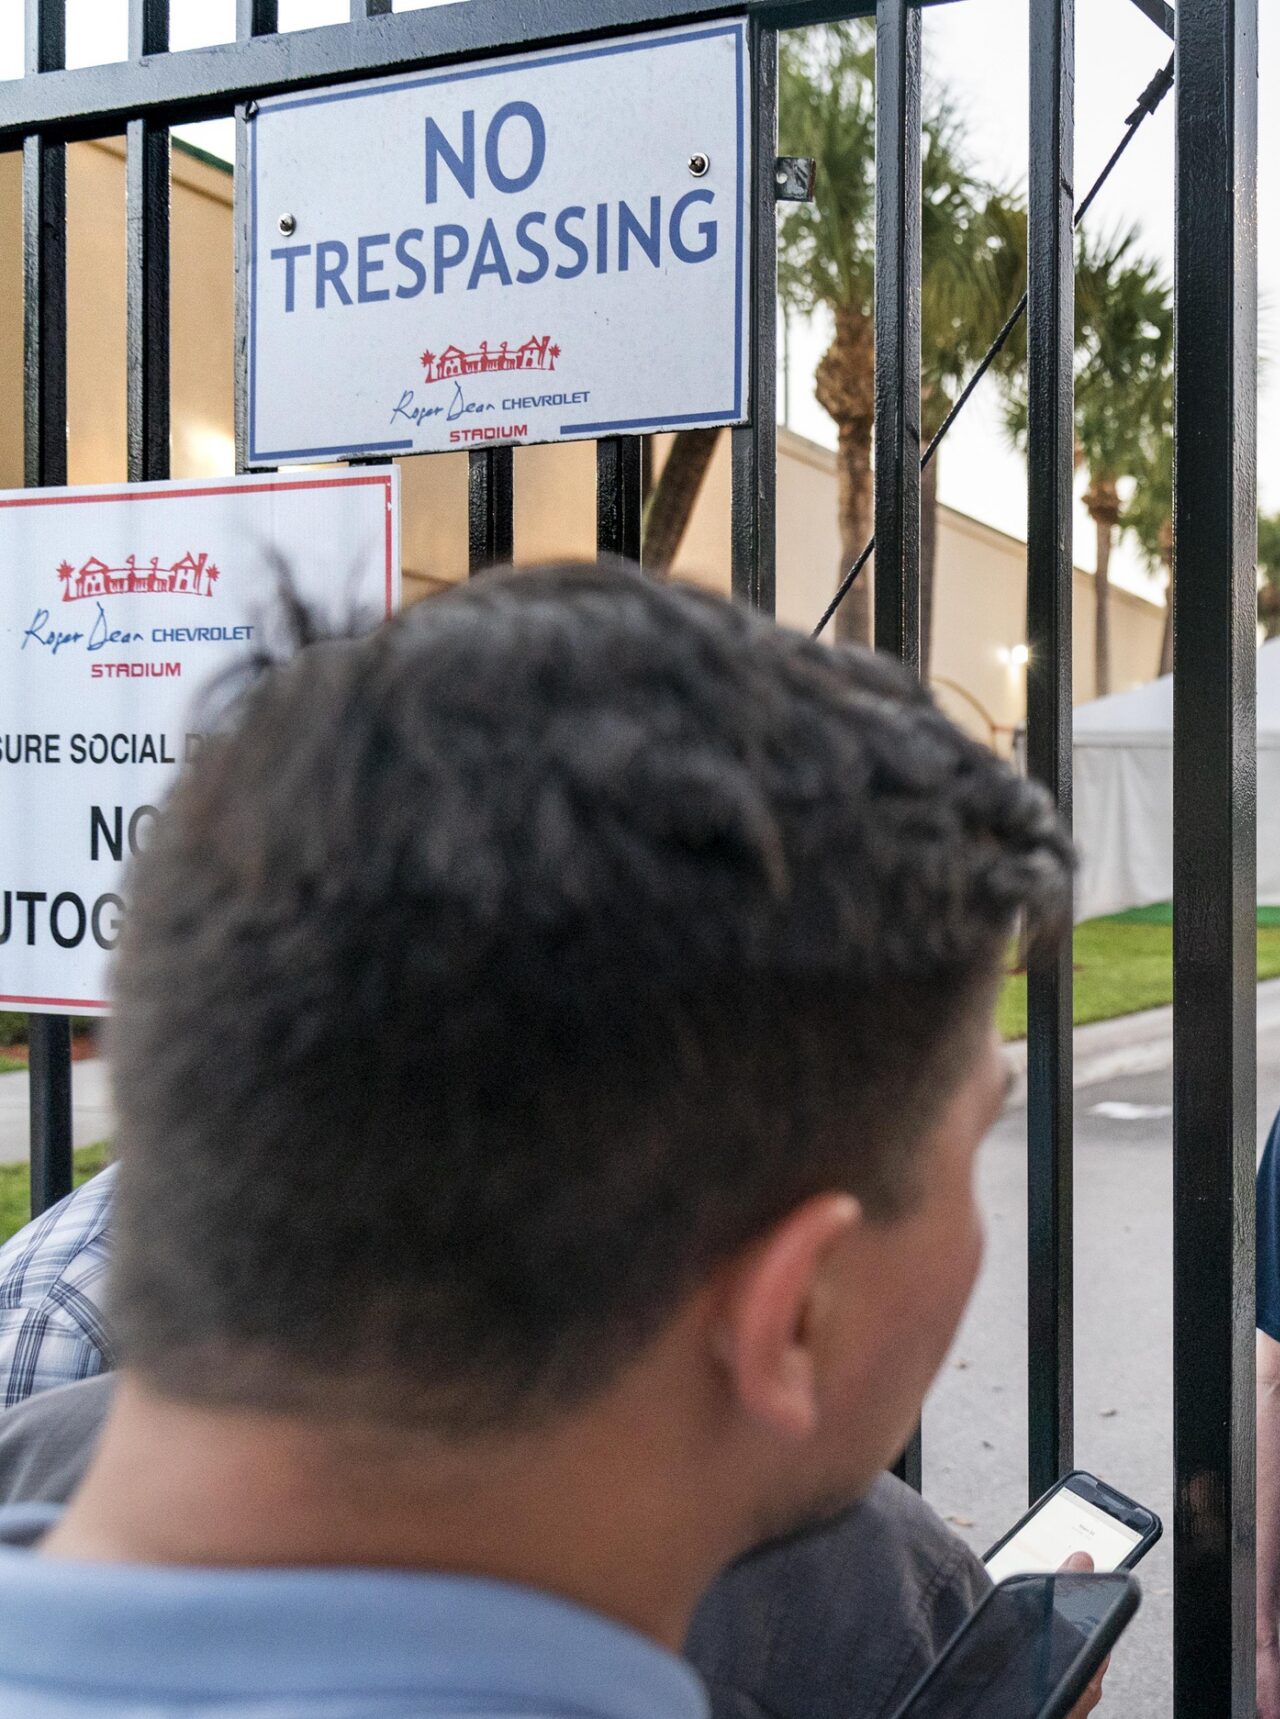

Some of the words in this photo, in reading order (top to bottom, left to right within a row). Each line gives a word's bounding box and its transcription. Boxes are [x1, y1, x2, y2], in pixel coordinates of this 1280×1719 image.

[425, 100, 546, 204] NO
[270, 189, 718, 312] TRESPASSING
[390, 390, 444, 426] Roger
[446, 380, 495, 421] Dean
[502, 391, 590, 411] CHEVROLET
[450, 424, 528, 443] STADIUM
[21, 608, 84, 655] Roger
[87, 601, 144, 651] Dean
[152, 626, 254, 642] CHEVROLET
[91, 662, 181, 678] STADIUM
[0, 734, 61, 764] URE
[70, 733, 175, 764] SOCIAL
